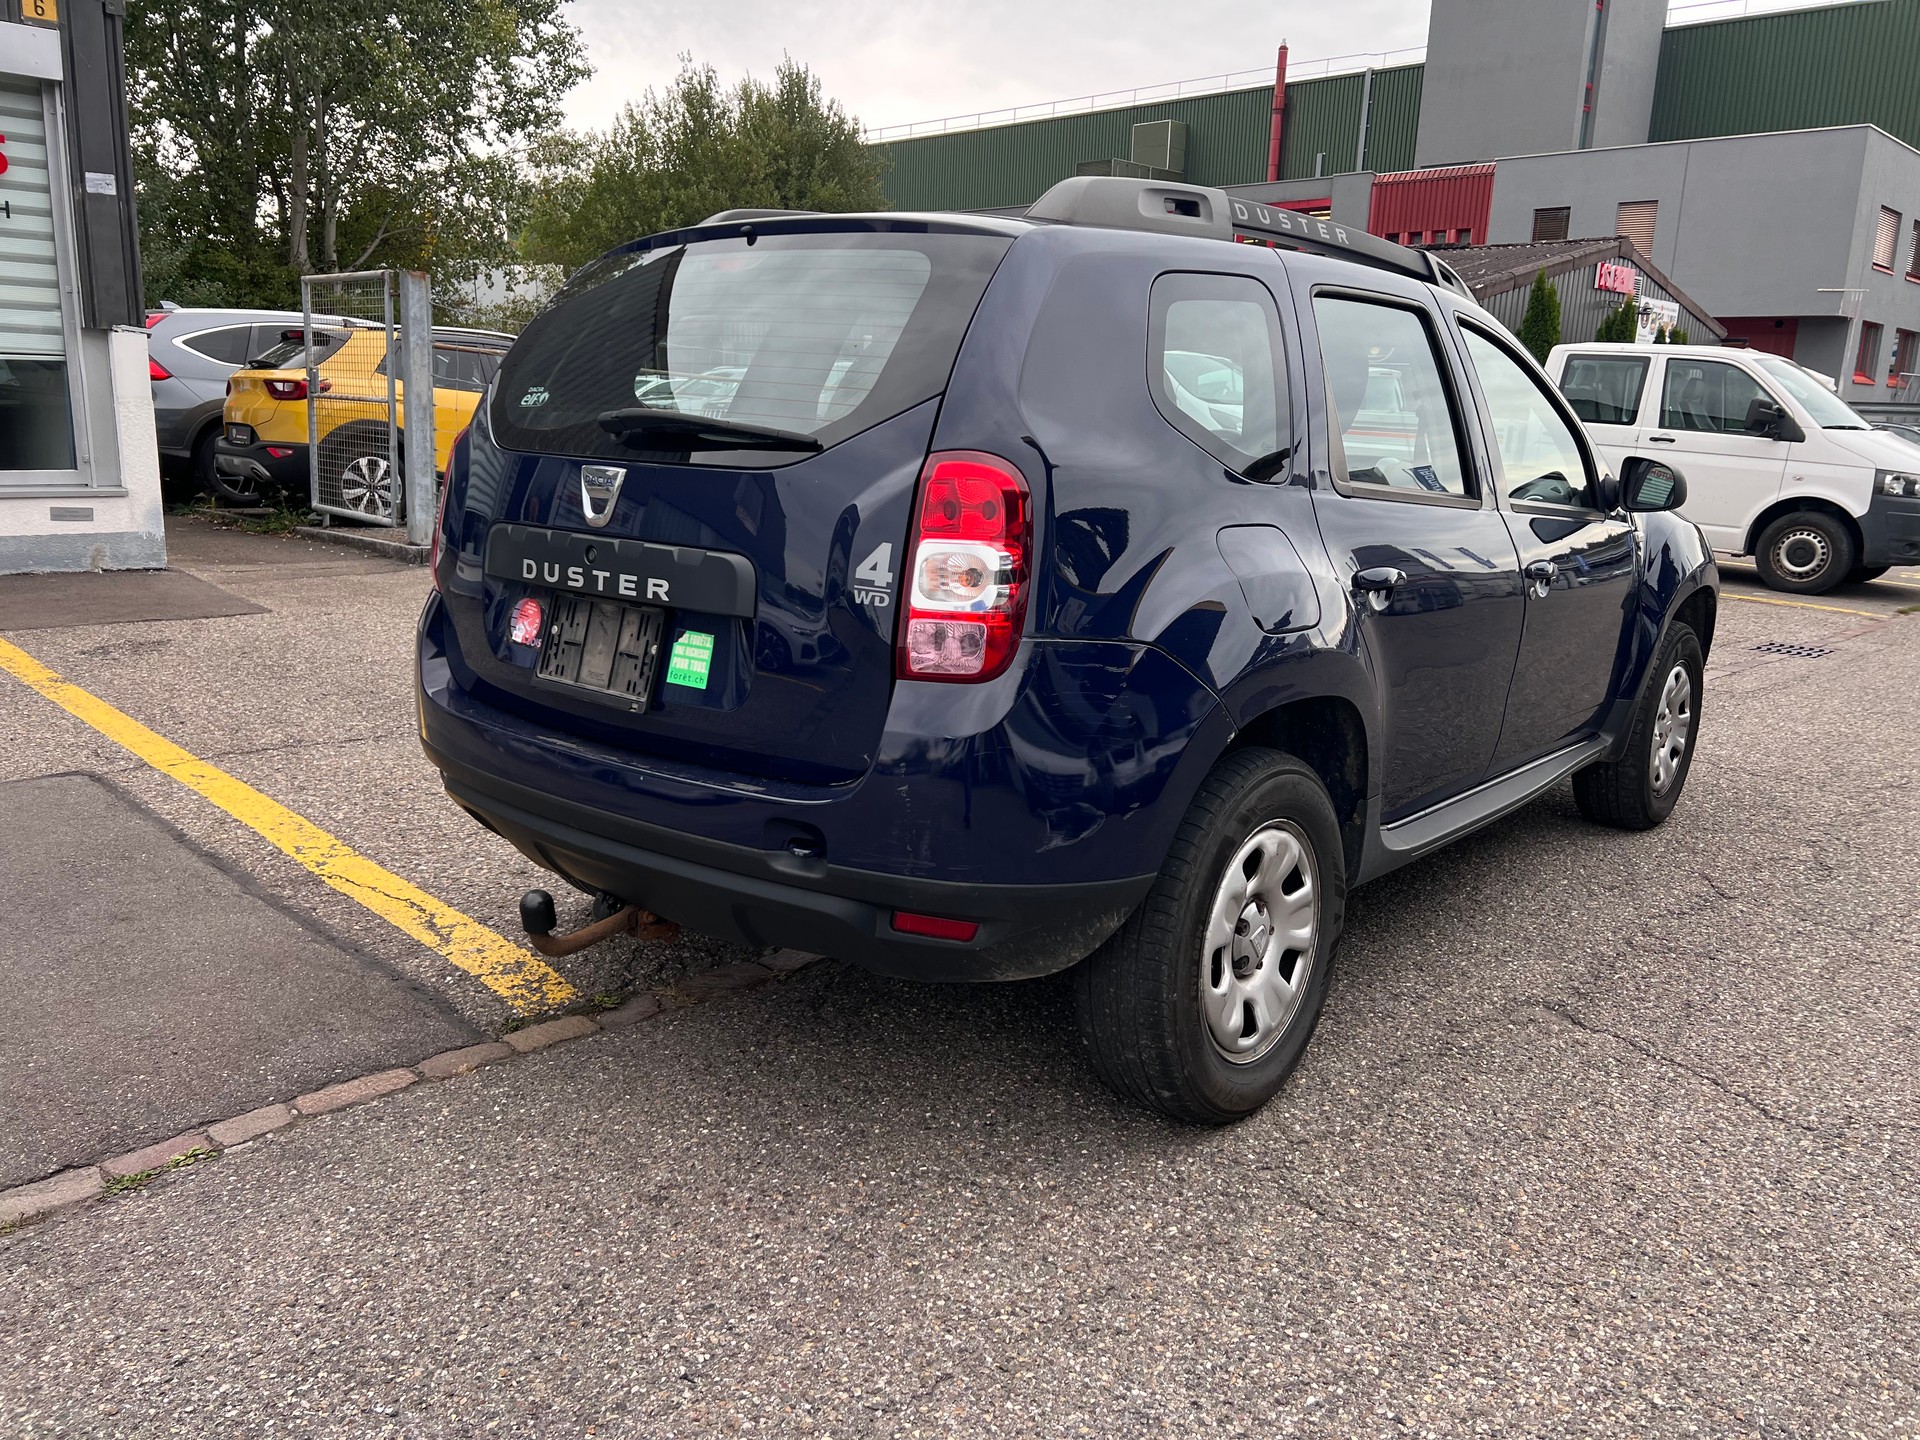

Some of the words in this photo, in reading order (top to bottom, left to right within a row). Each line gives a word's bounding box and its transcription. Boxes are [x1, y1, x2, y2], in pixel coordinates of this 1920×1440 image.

[1234, 203, 1350, 245] DUSTER
[585, 475, 615, 487] DACIA
[855, 542, 894, 588] 4
[522, 558, 670, 602] DUSTER
[854, 590, 890, 607] WD
[669, 670, 705, 684] forêt.ch
